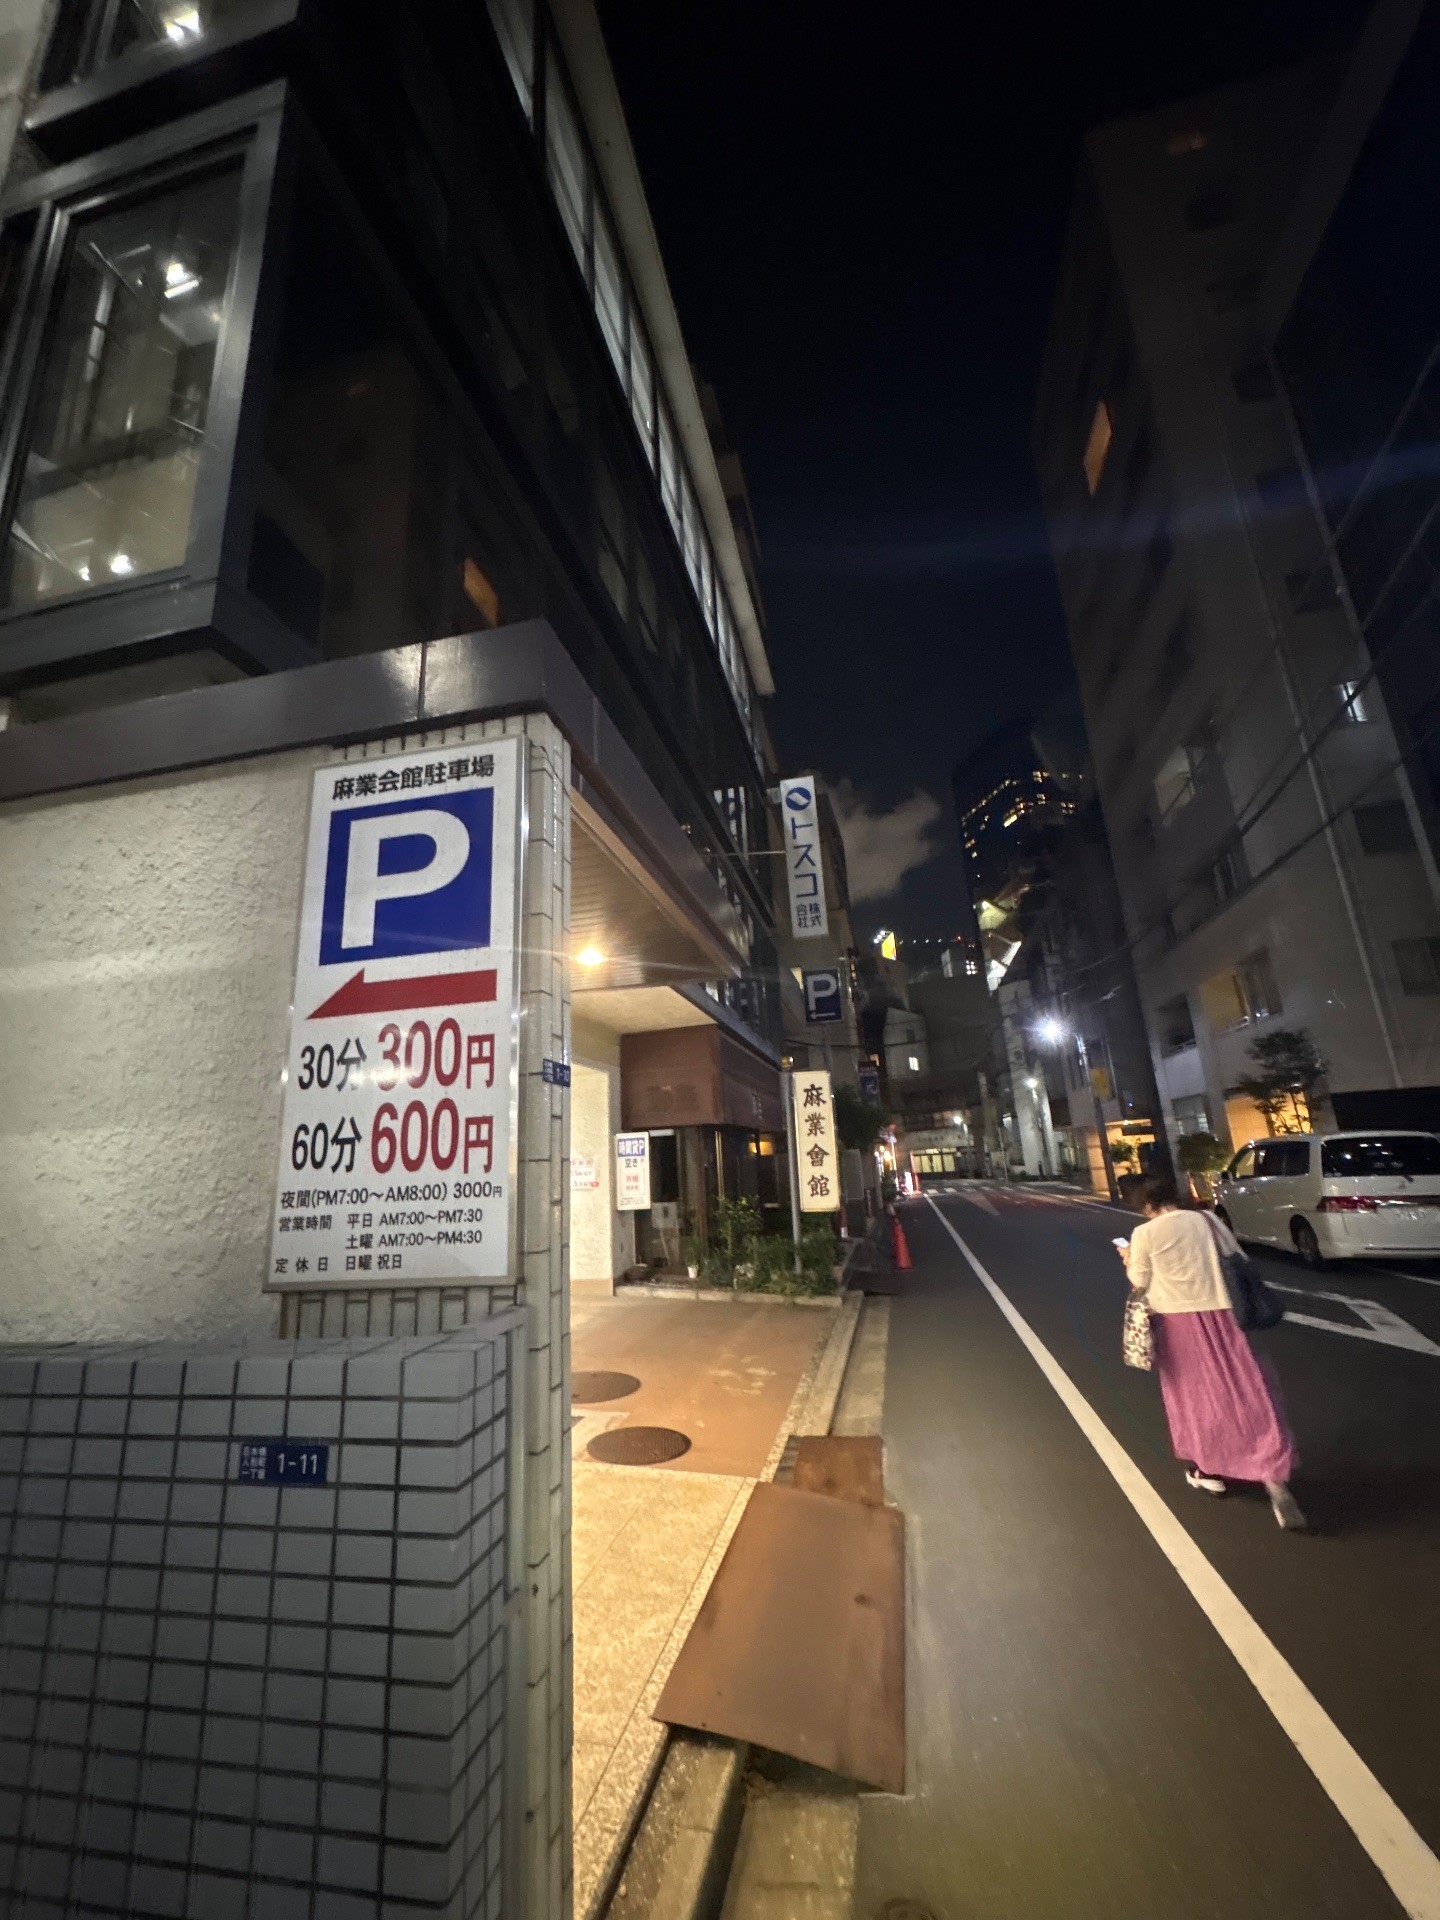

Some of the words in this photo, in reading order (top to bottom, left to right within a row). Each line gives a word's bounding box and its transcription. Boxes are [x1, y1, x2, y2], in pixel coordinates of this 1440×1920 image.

[332, 754, 495, 801] 麻業会館駐車場
[341, 809, 470, 950] P
[791, 817, 819, 899] トスコ
[806, 973, 838, 1012] P
[298, 1037, 368, 1091] 30分
[376, 1017, 496, 1092] 300円
[291, 1115, 363, 1174] 60分
[370, 1097, 494, 1174] 600円
[803, 1084, 831, 1199] 麻業會館
[453, 1181, 503, 1200] 3000円
[279, 1215, 333, 1232] 営業時間
[347, 1213, 373, 1229] 平日
[345, 1234, 373, 1250] 土曜
[345, 1255, 373, 1271] 日曜
[377, 1254, 403, 1270] 祝日
[278, 1452, 318, 1475] 1-11
